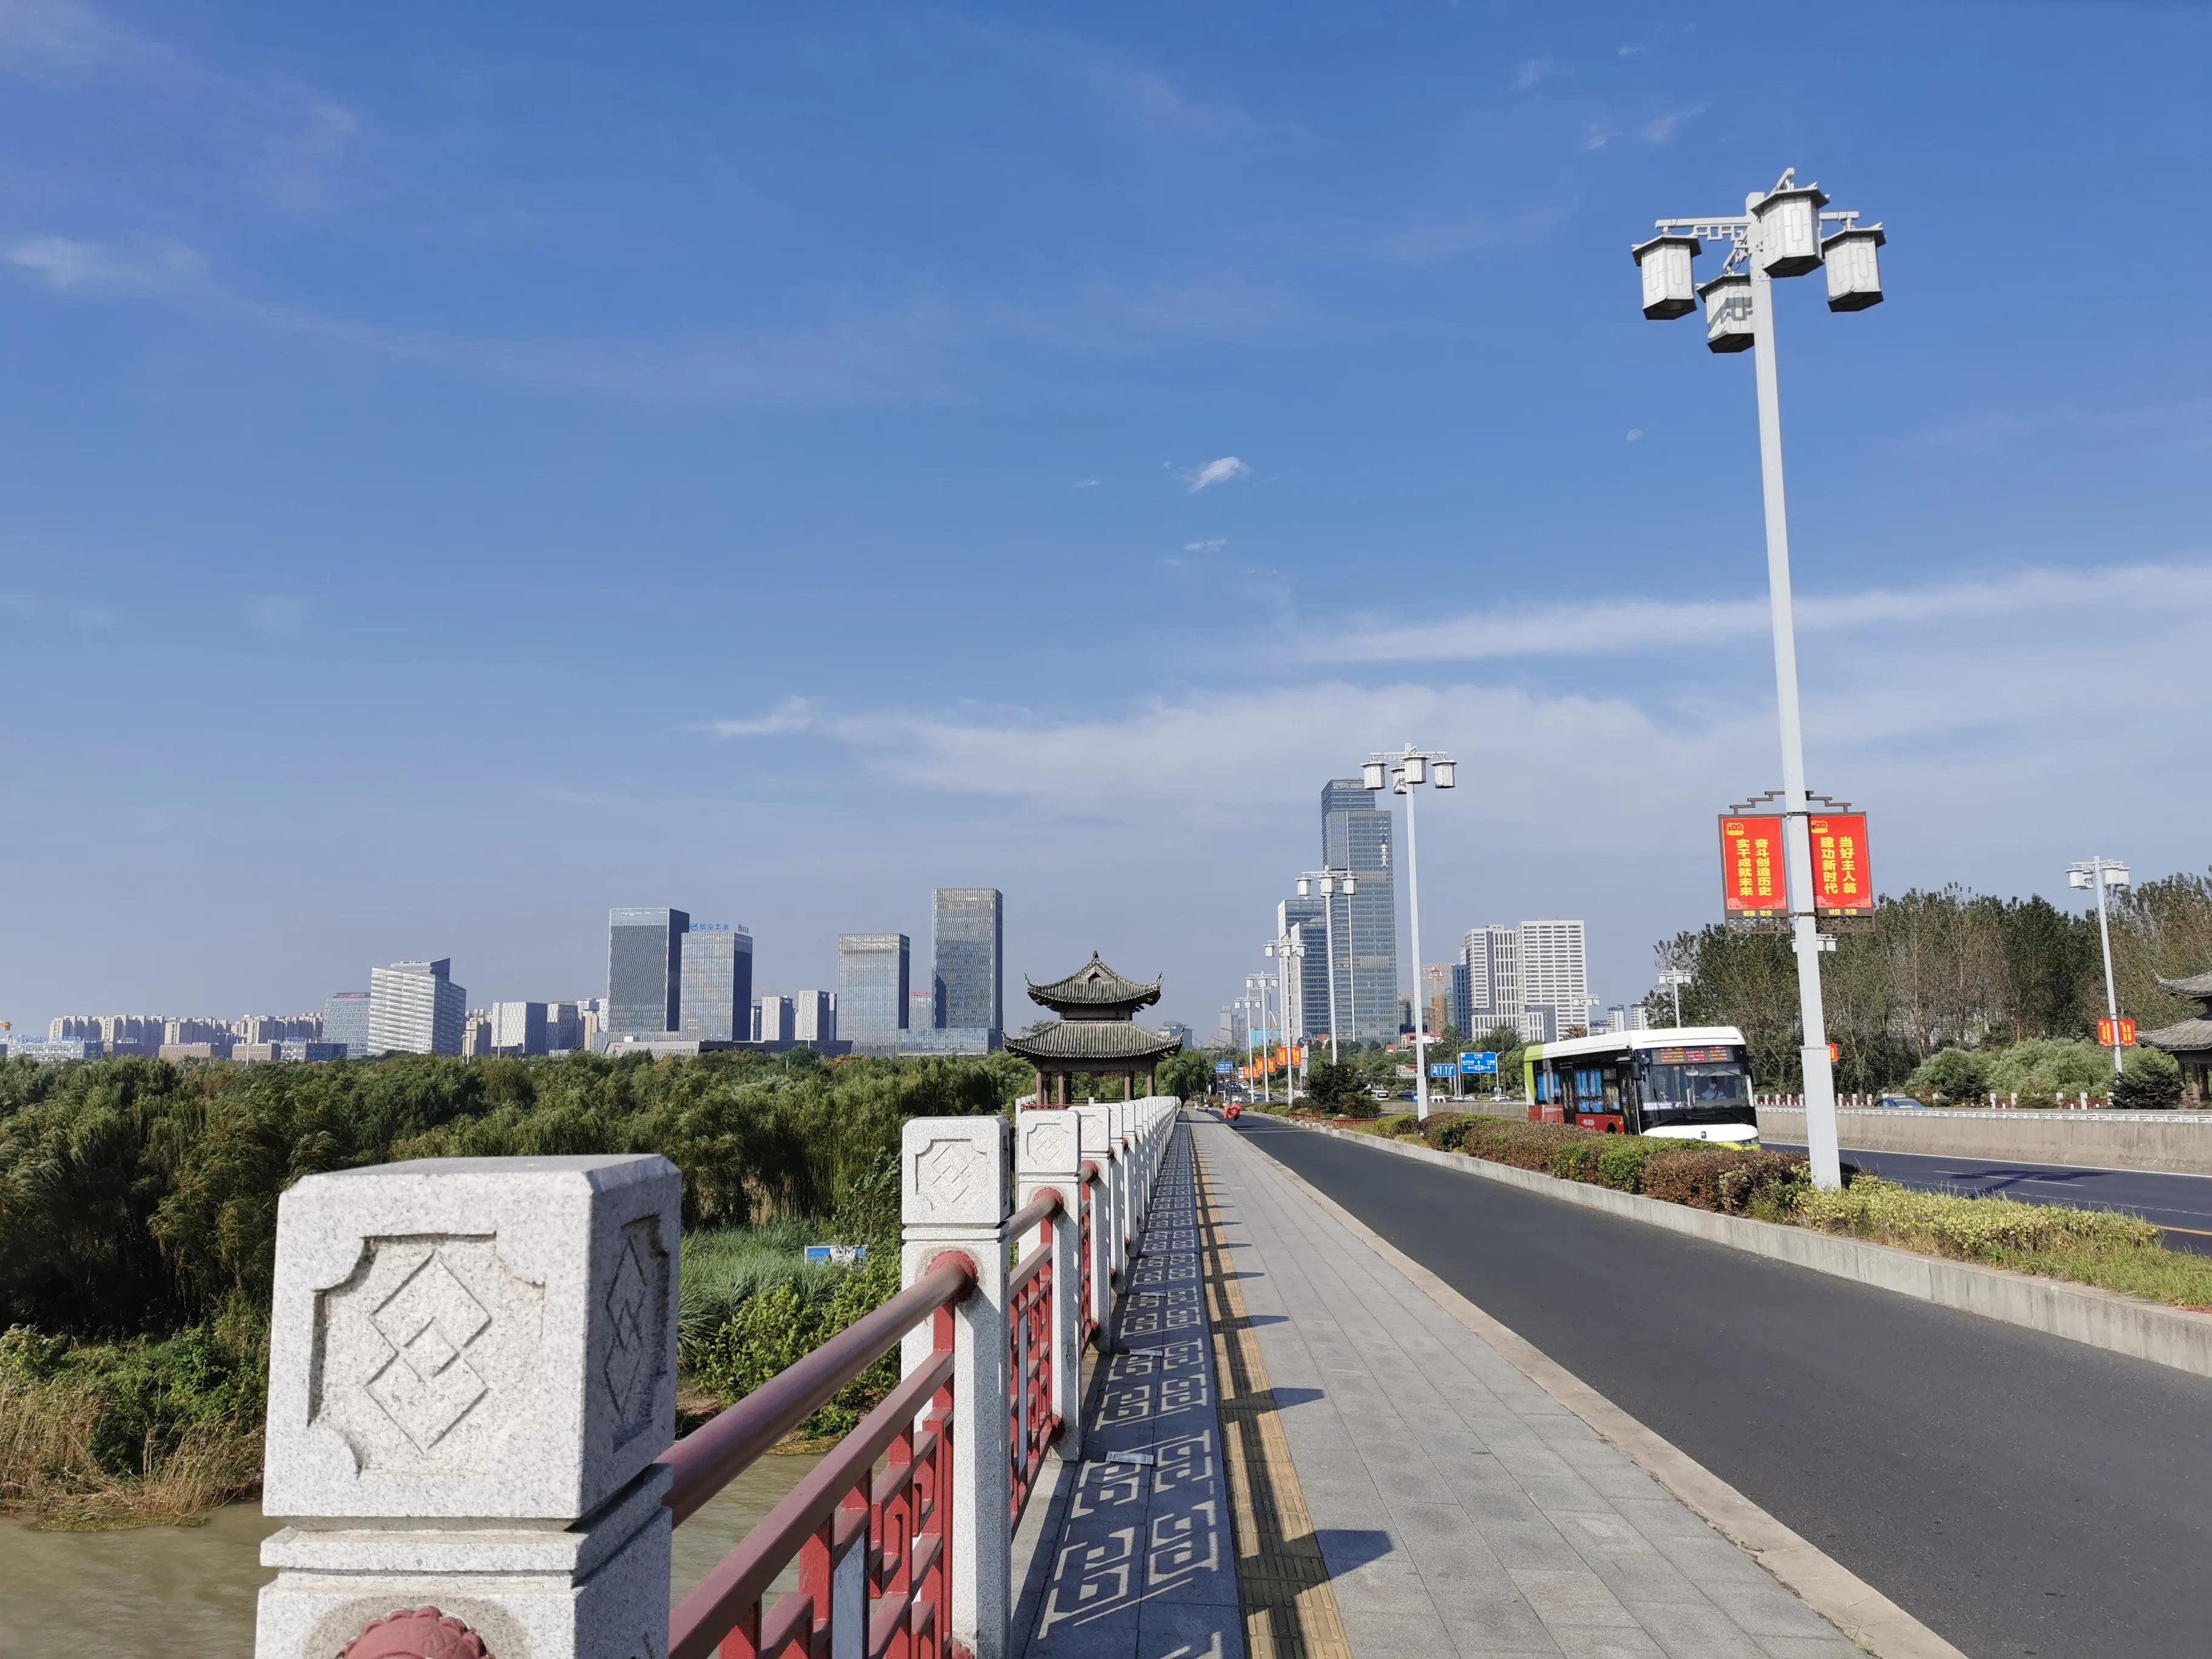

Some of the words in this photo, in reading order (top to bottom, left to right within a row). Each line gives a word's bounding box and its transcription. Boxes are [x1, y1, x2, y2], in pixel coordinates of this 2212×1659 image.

[1736, 839, 1754, 897] 实干成就未来
[1754, 839, 1772, 896] 奋斗创造历史
[1820, 837, 1838, 894] 建功新时代
[1839, 836, 1857, 894] 当好主人翁
